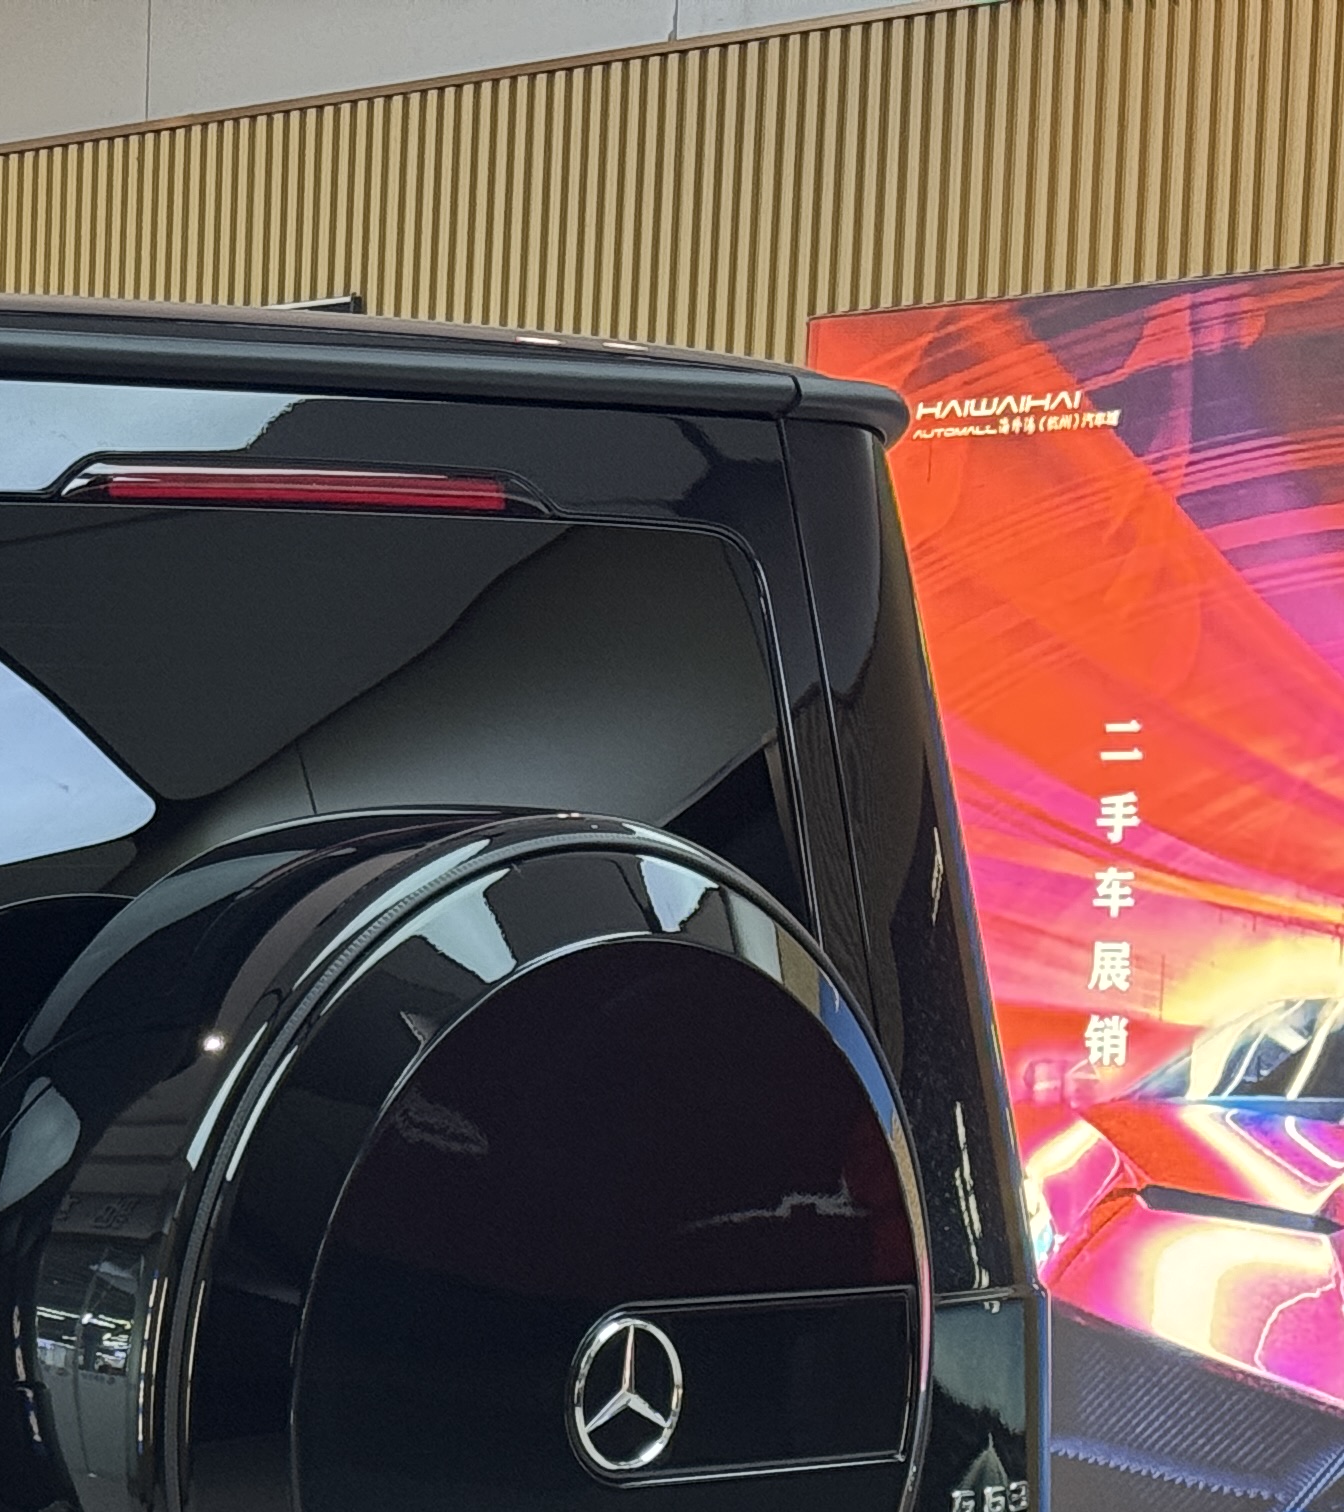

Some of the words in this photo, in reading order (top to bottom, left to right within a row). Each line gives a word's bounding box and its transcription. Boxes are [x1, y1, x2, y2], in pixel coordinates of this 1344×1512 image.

[915, 390, 1082, 420] HAIWAIHAI
[1084, 719, 1143, 1067] 二手车展销
